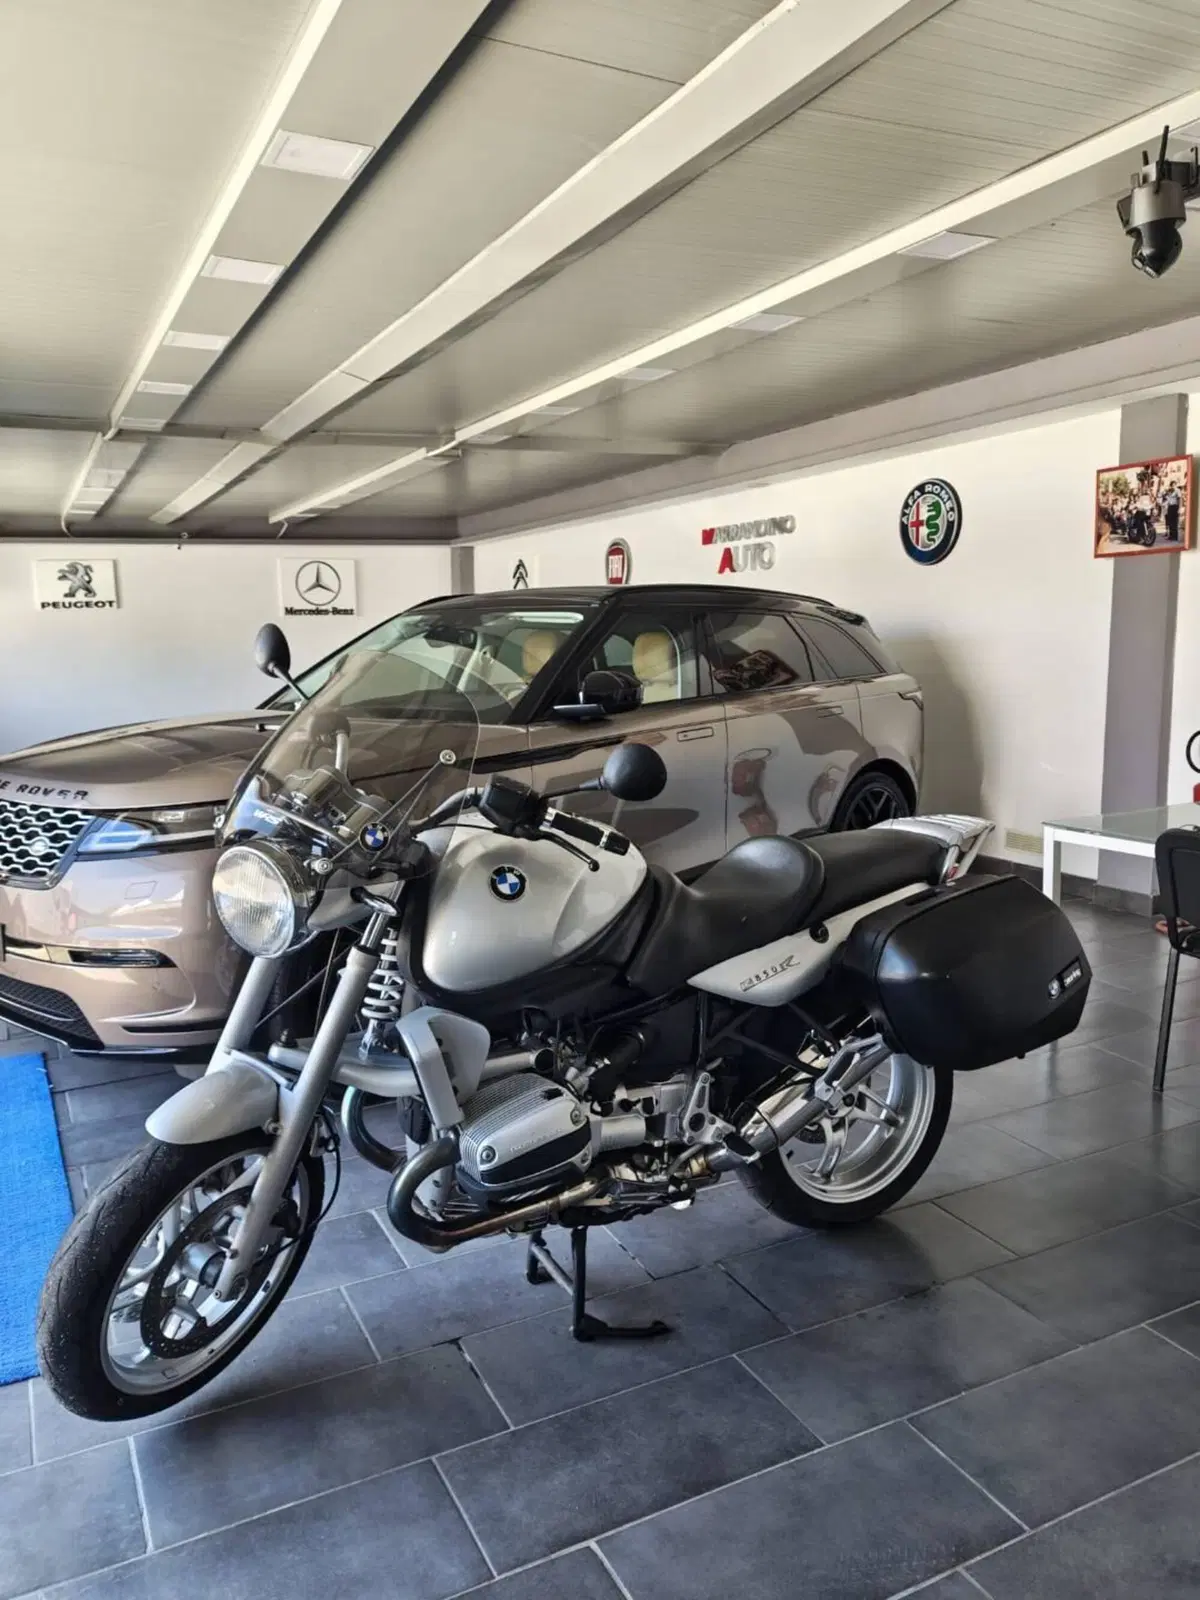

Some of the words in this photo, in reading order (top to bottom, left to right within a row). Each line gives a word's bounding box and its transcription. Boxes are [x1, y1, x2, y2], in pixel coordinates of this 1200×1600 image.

[902, 489, 921, 525] ALFA
[924, 484, 955, 522] ROMEO
[718, 541, 776, 574] AUTO
[40, 600, 116, 610] PEUGEOT
[284, 606, 355, 616] Mercedes-Benz
[16, 783, 89, 800] ROVER
